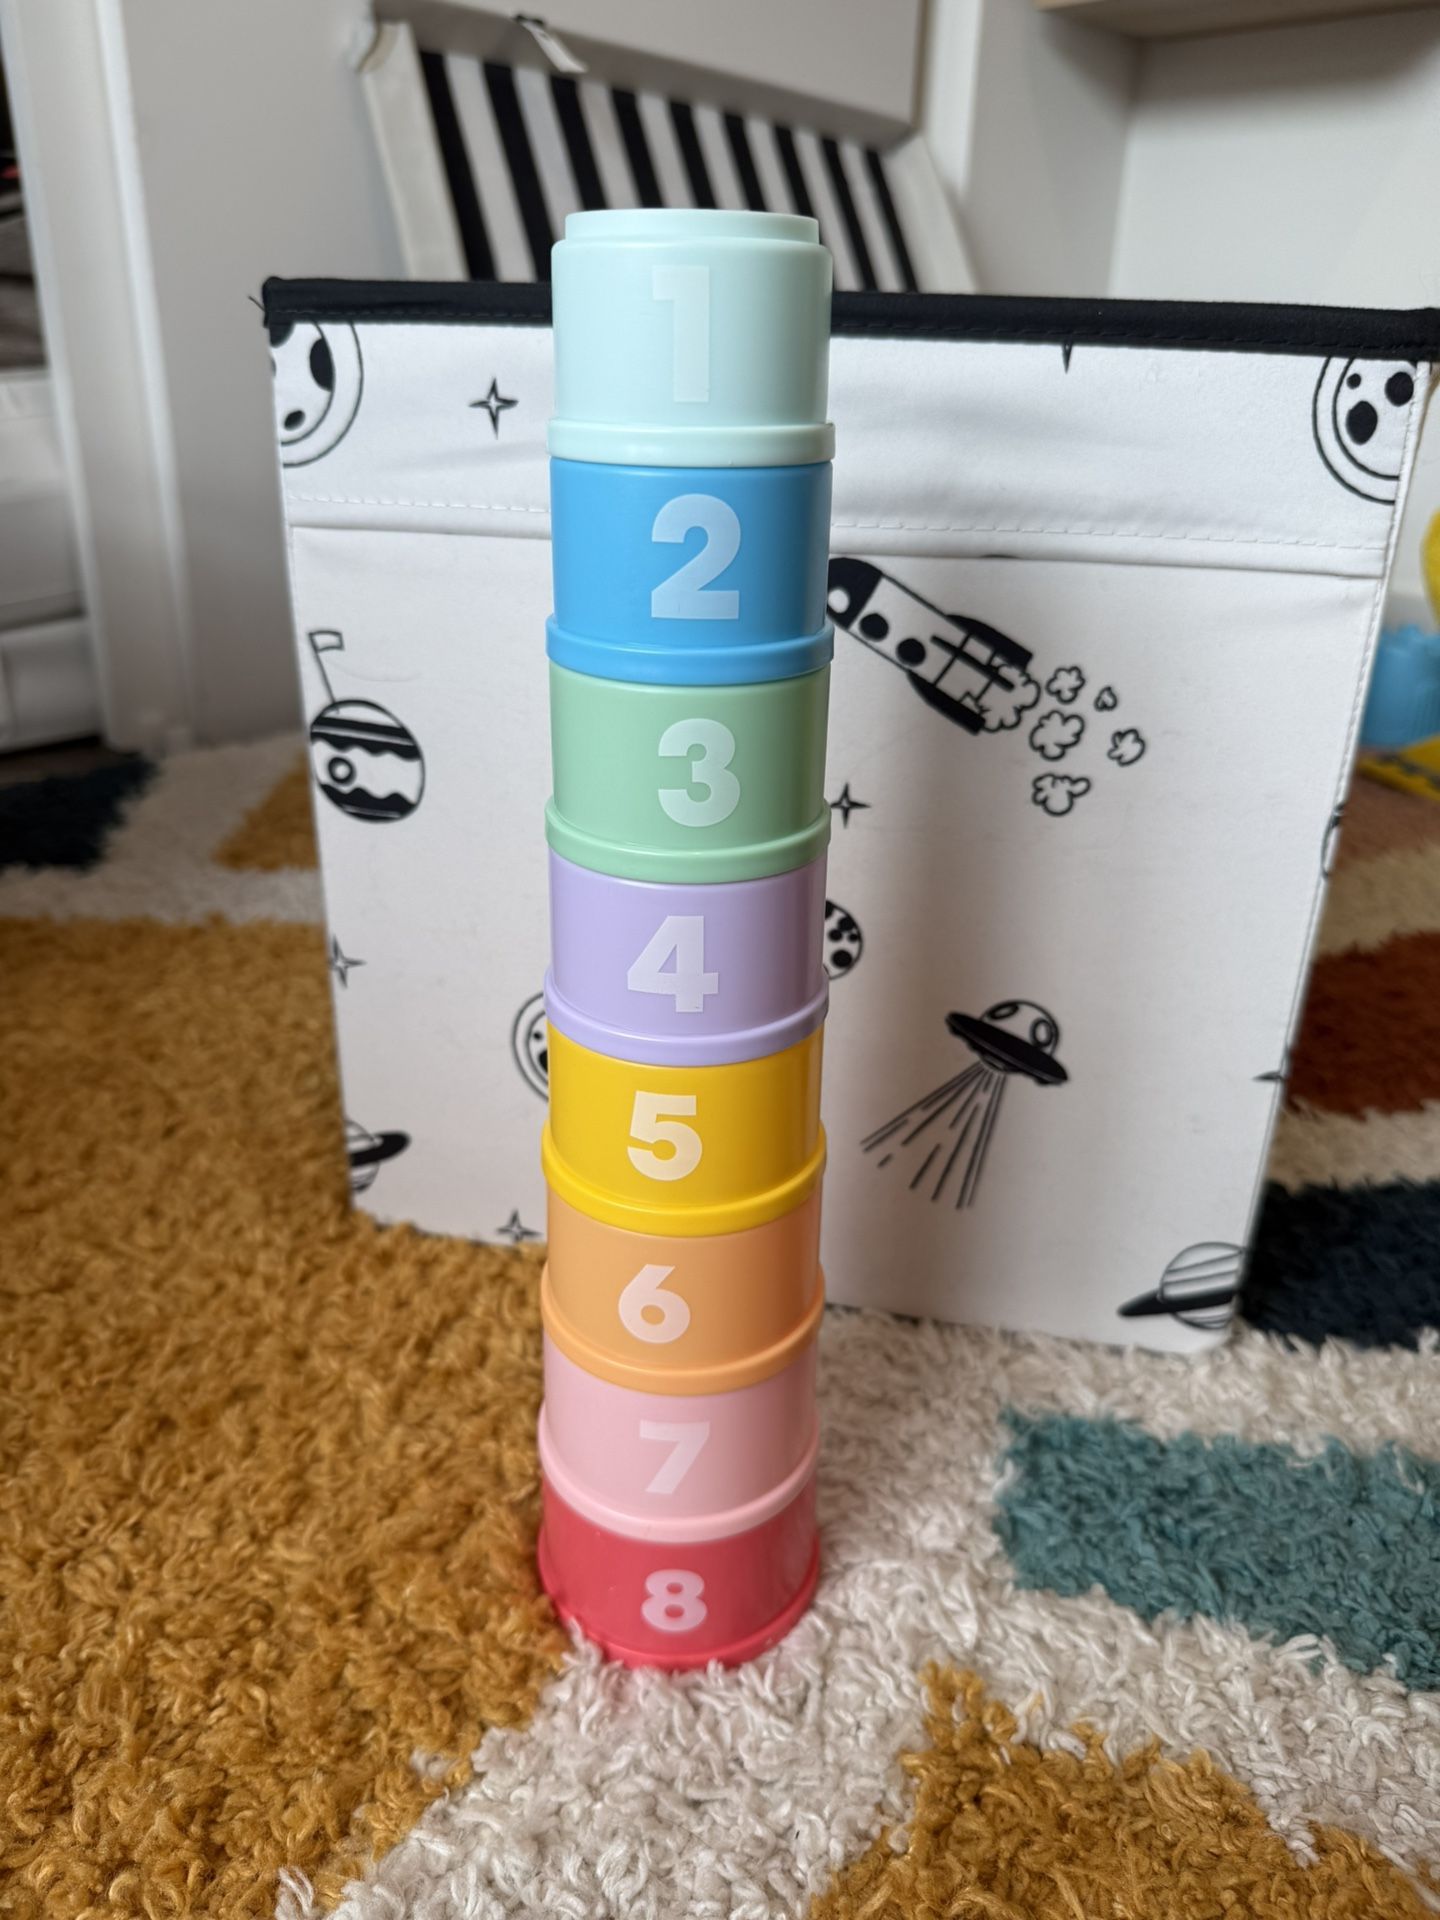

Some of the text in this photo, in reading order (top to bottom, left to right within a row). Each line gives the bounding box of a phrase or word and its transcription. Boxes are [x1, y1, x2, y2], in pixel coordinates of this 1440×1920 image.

[652, 265, 710, 403] 1
[651, 493, 741, 620] 2
[658, 718, 741, 827] 3
[627, 915, 719, 1013] 4
[627, 1090, 702, 1181] 5
[618, 1263, 691, 1344] 6
[639, 1419, 711, 1495] 7
[640, 1568, 707, 1632] 8
